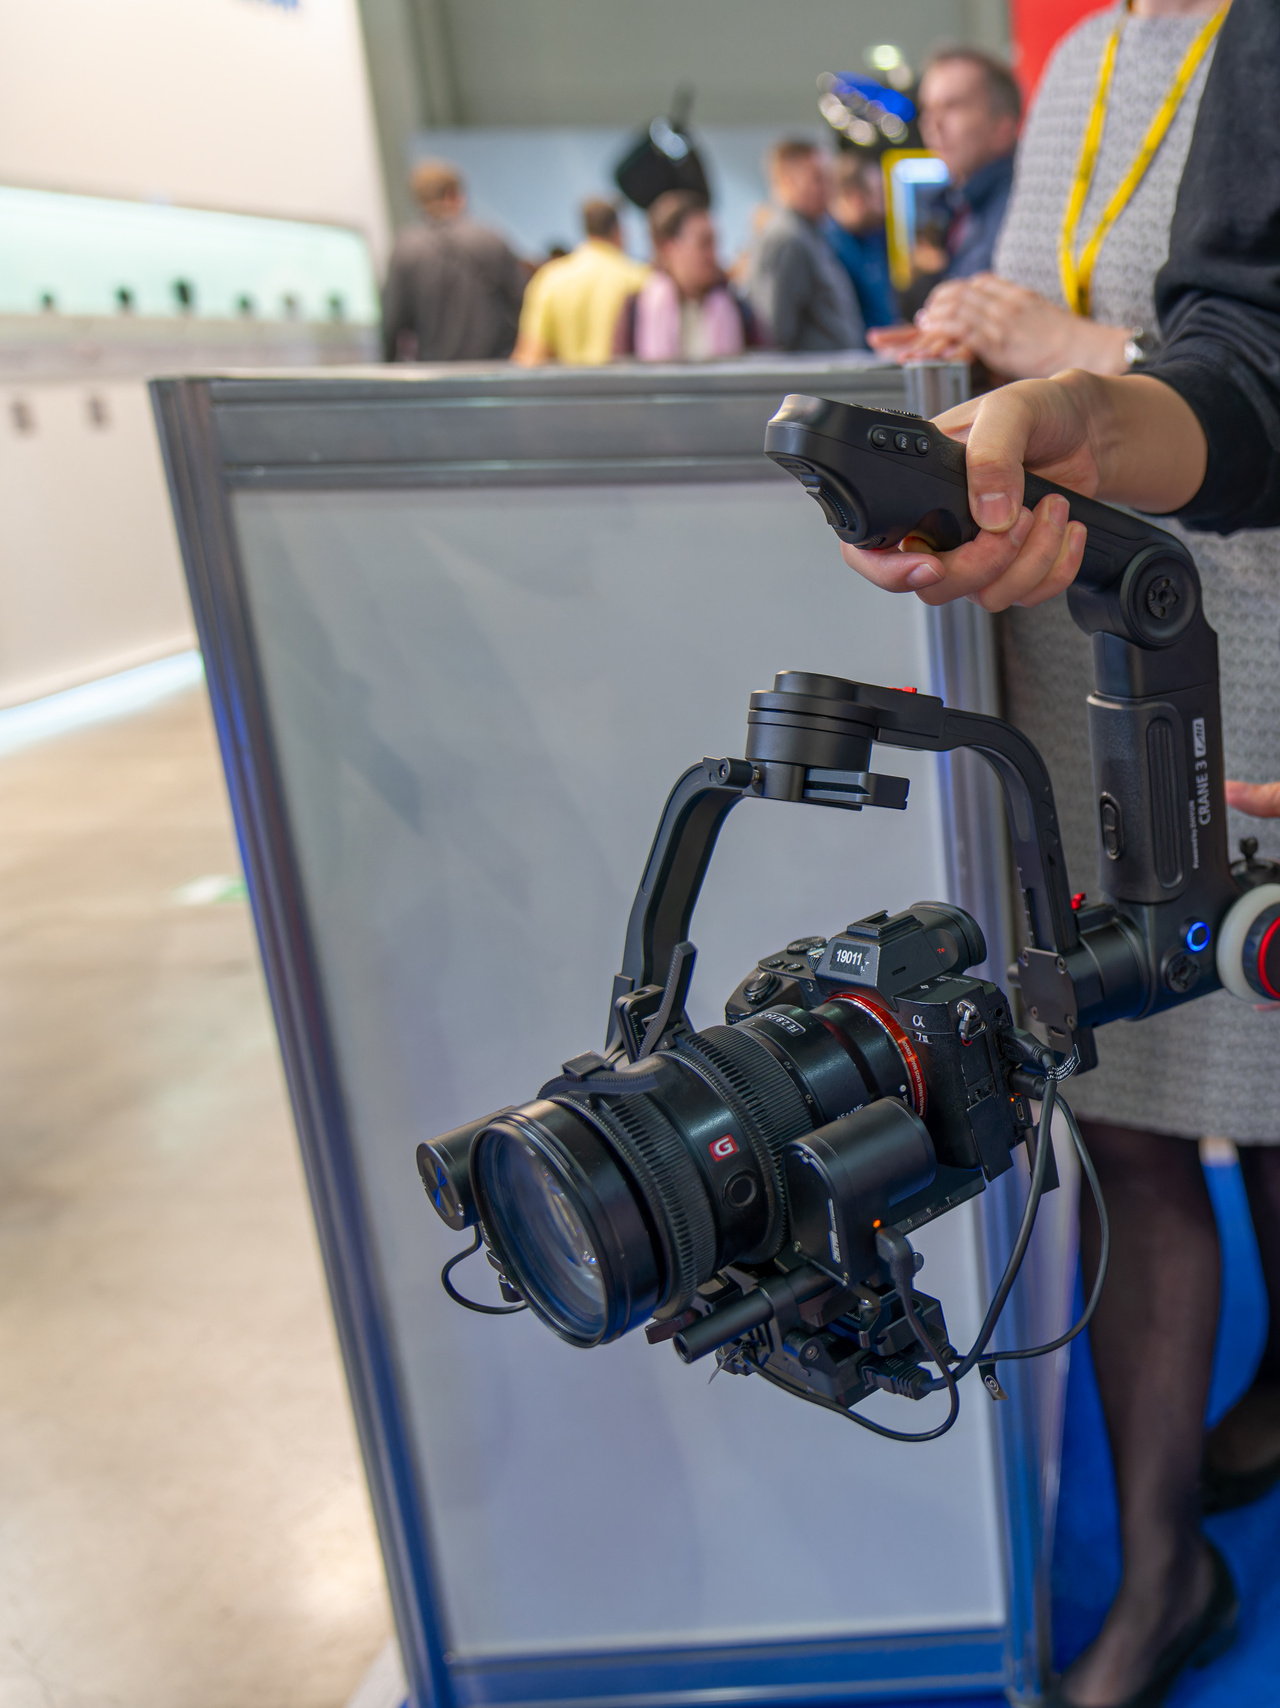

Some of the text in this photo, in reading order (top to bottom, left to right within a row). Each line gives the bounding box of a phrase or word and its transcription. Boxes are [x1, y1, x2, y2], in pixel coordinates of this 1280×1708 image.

[1195, 759, 1208, 770] 3
[1196, 772, 1211, 825] CRANE
[836, 949, 863, 966] 19011
[901, 1039, 913, 1057] SENSOR
[714, 1137, 734, 1157] G
